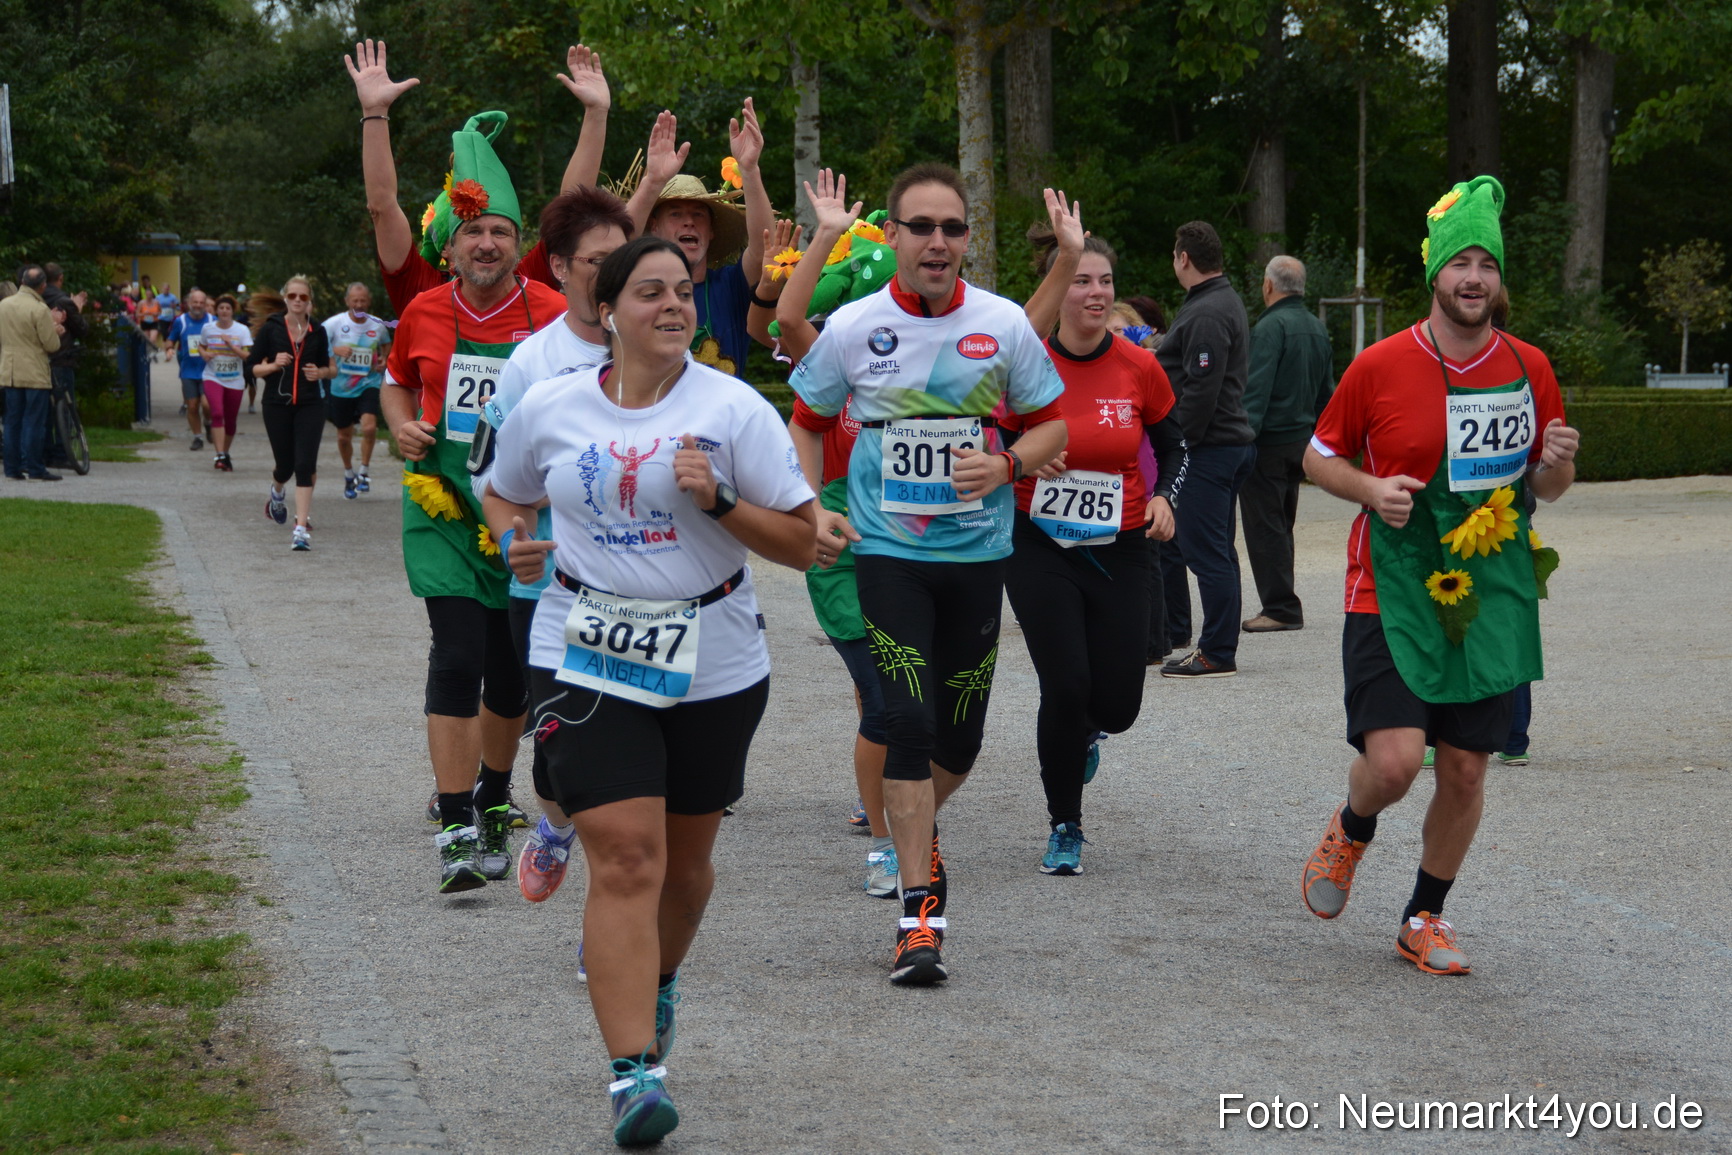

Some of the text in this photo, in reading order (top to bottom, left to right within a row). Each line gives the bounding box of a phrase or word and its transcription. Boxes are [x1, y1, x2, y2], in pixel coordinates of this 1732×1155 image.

[963, 340, 995, 353] Hervis
[216, 362, 238, 372] 2299
[452, 362, 483, 374] PARTL
[869, 360, 900, 369] PARTL
[869, 368, 901, 376] Neumarkt
[457, 376, 496, 408] 20
[1449, 401, 1522, 414] PARTL Neuma
[885, 427, 967, 438] PARTL Neumarkt
[1459, 410, 1531, 454] 2423
[892, 441, 974, 478] 301
[1469, 457, 1522, 476] Johannes
[1068, 477, 1109, 488] Neumarkt
[897, 483, 957, 502] BENN
[1040, 486, 1114, 521] 2785
[650, 510, 673, 520] 2015
[955, 506, 998, 521] Neumarkter
[1056, 524, 1092, 538] Franzi
[578, 596, 677, 621] PARTL Neumarkt
[578, 615, 688, 664] 3047
[583, 653, 668, 695] ANGELA
